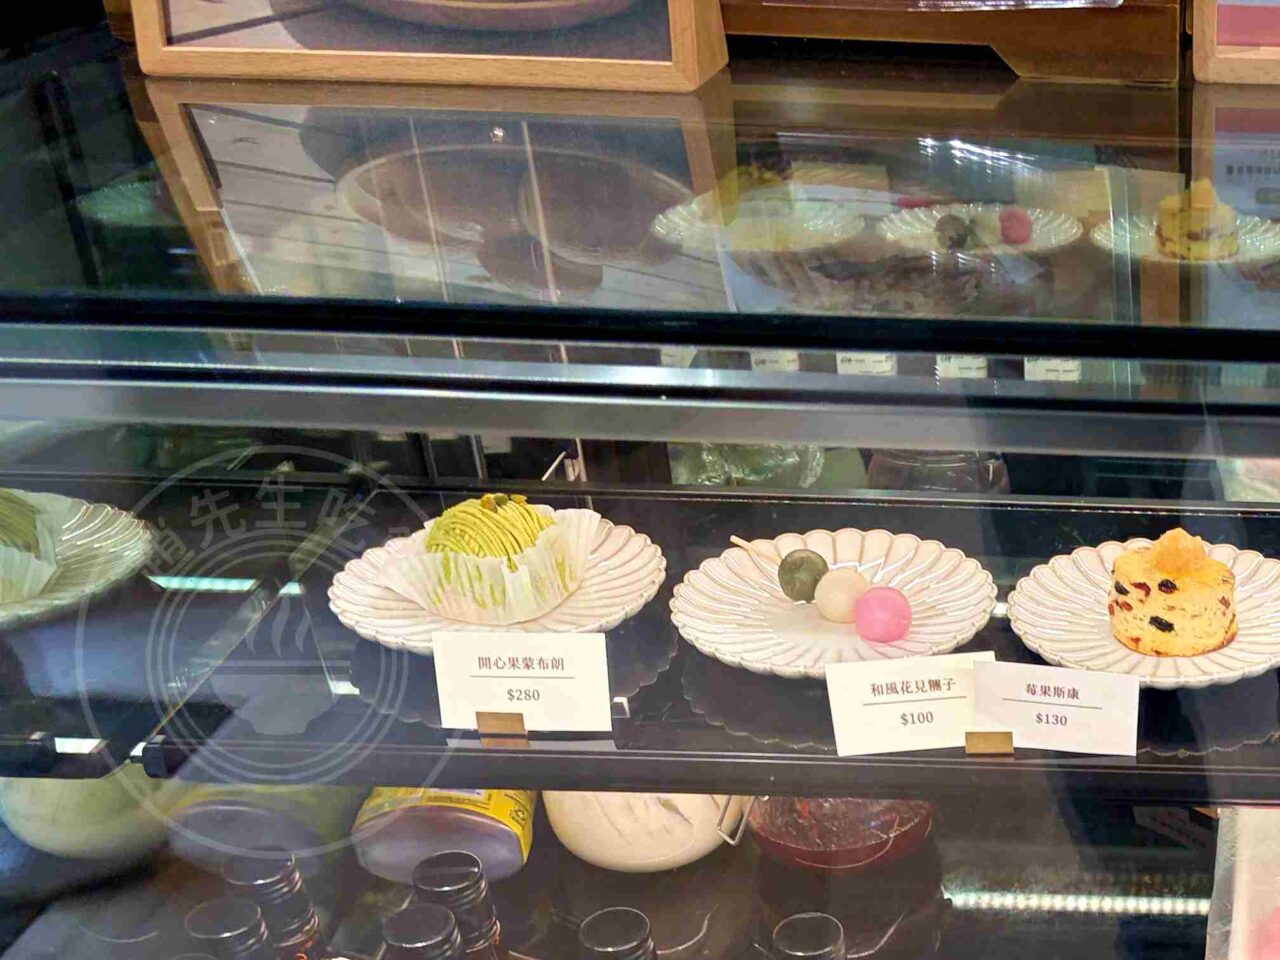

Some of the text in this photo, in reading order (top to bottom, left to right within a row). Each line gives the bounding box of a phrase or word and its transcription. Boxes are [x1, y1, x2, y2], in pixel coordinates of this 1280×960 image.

[477, 656, 565, 671] 開心果蒙布朗
[871, 677, 956, 697] 和風花見糰子
[1025, 683, 1080, 700] 莓果斯康
[506, 688, 540, 702] $280
[900, 711, 934, 726] $100
[1035, 712, 1068, 726] $130
